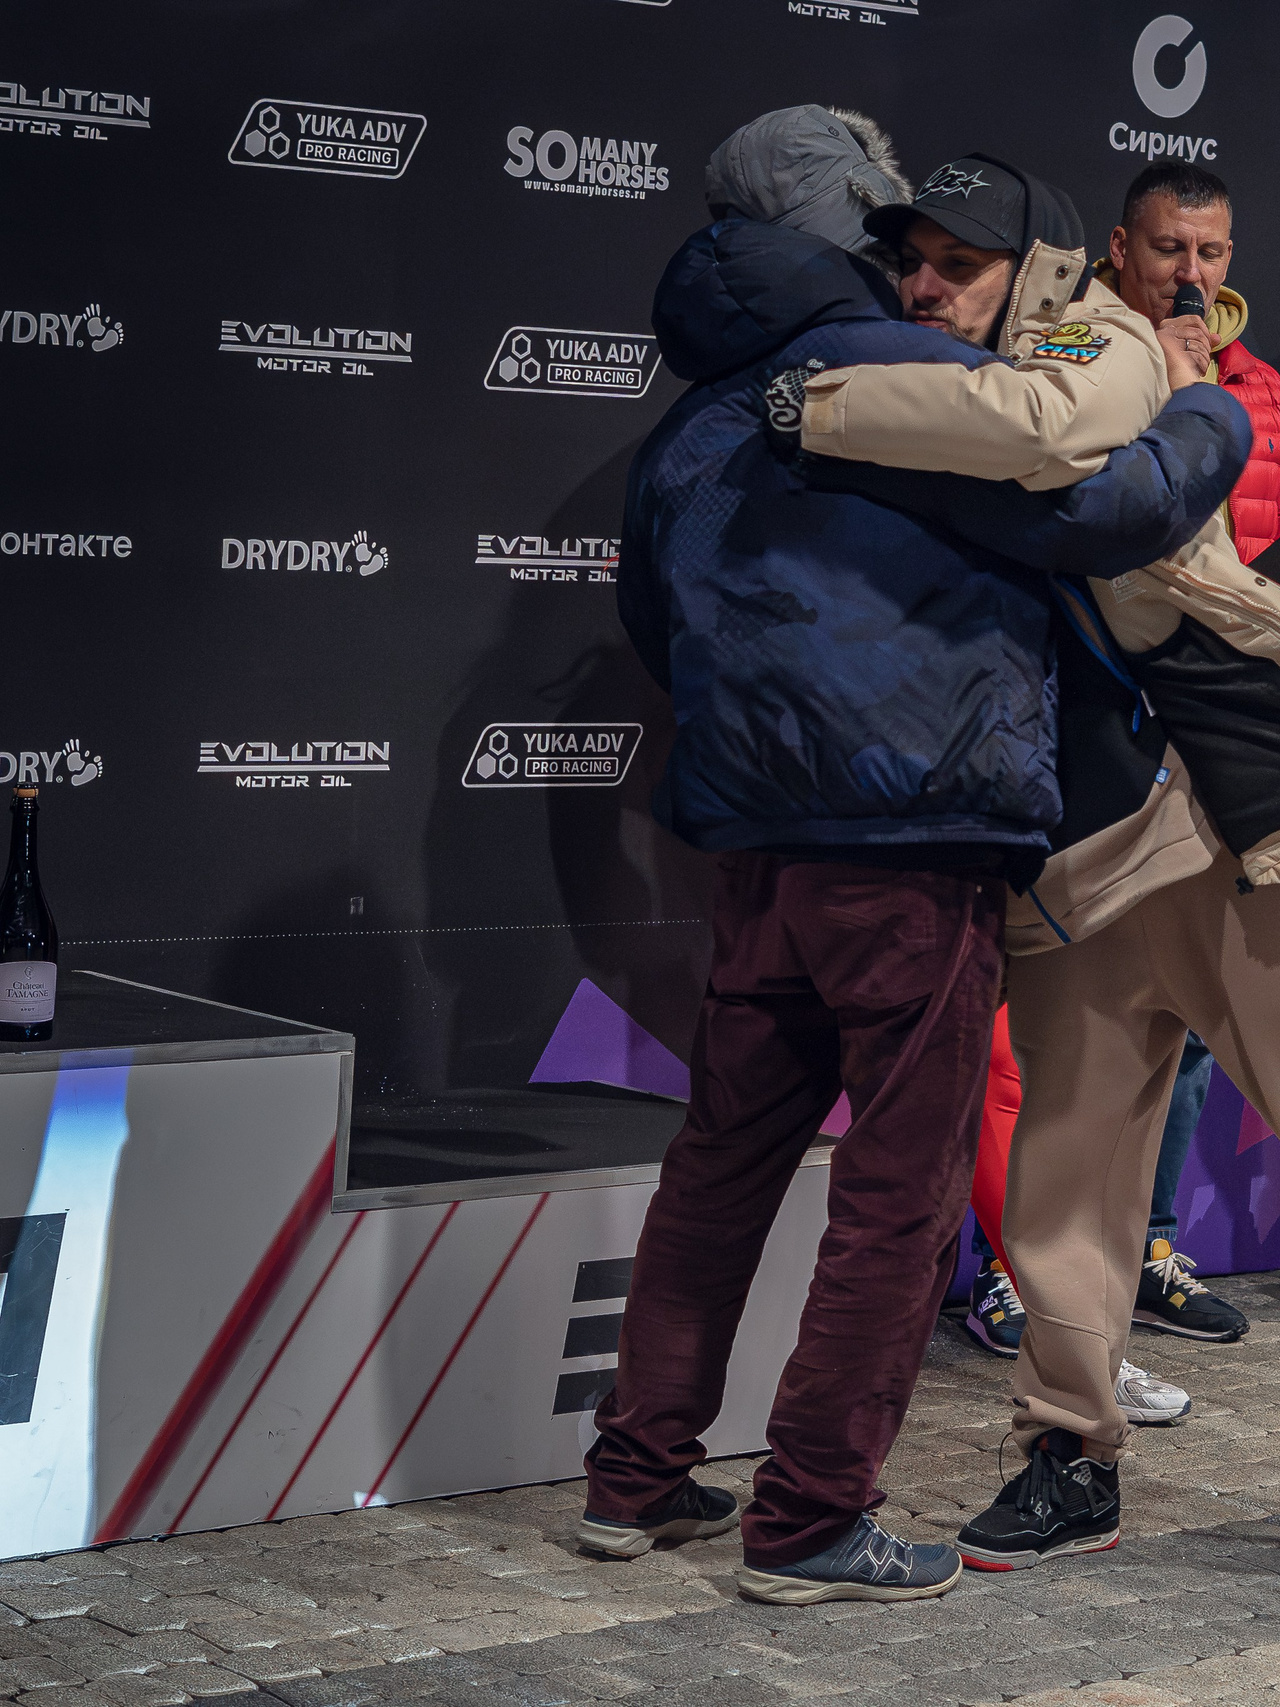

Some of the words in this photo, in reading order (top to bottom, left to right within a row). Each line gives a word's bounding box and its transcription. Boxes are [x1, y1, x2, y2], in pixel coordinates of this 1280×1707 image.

[787, 1, 850, 20] MOTOR
[859, 11, 887, 25] OIL
[73, 125, 108, 140] OIL
[297, 112, 357, 140] YUKA
[360, 120, 407, 143] ADV
[579, 136, 658, 166] MANY
[1108, 121, 1218, 163] Сириус
[305, 144, 334, 159] PRO
[337, 147, 392, 164] RACING
[503, 125, 578, 181] SO
[578, 159, 670, 191] HORSES
[524, 180, 646, 200] www.somanyhorses.ru
[221, 320, 412, 352] EVOLUTION
[546, 339, 601, 361] YUKA
[605, 343, 648, 364] ADV
[256, 356, 332, 374] MOTOR
[342, 362, 374, 376] OIL
[555, 367, 581, 381] PRO
[585, 369, 635, 385] RACING
[0, 531, 133, 558] онтакте
[221, 538, 351, 572] DRYDRY
[510, 568, 578, 582] MOTOR
[588, 570, 617, 582] OIL
[200, 741, 390, 762] EVOLUTION
[523, 733, 579, 753] YUKA
[582, 733, 625, 753] ADV
[532, 761, 559, 773] PRO
[562, 761, 612, 773] RACING
[236, 775, 310, 788] MOTOR
[320, 775, 352, 787] OIL
[6, 989, 49, 998] TAMAGNE
